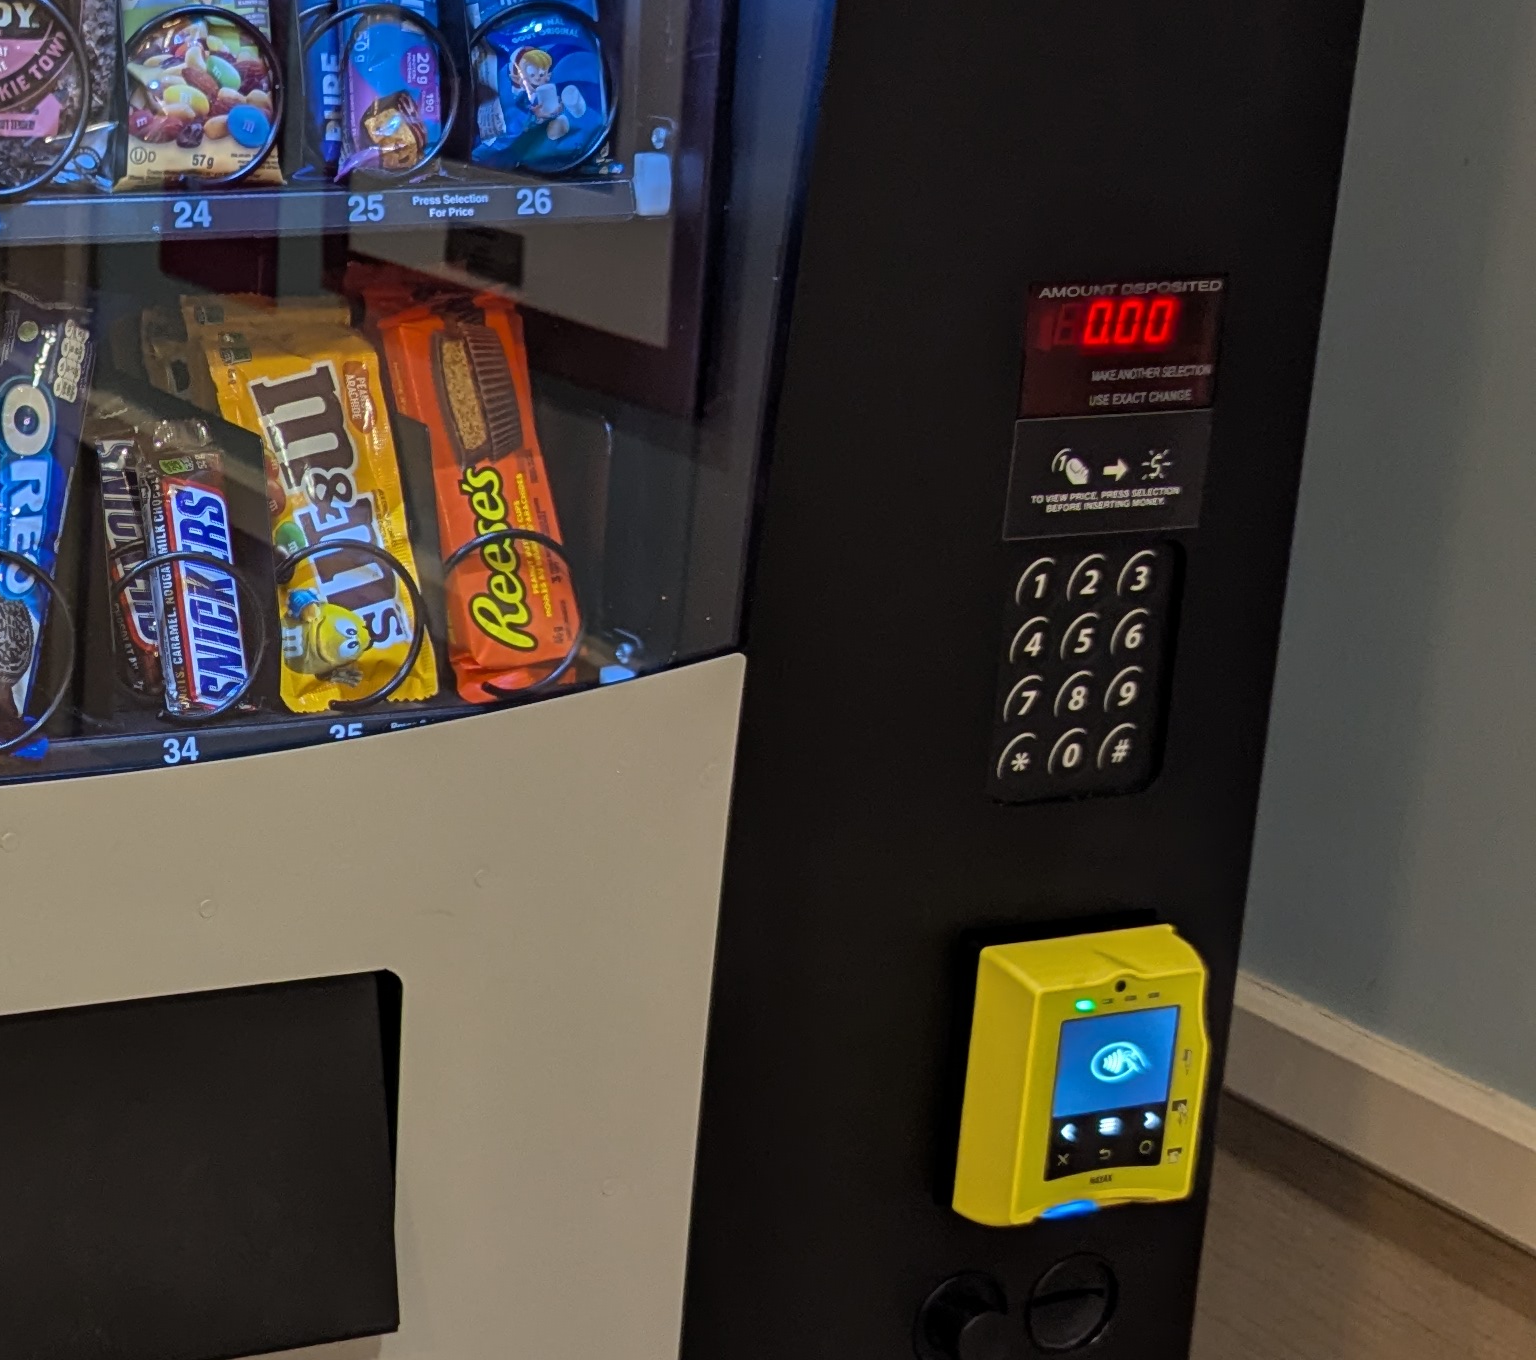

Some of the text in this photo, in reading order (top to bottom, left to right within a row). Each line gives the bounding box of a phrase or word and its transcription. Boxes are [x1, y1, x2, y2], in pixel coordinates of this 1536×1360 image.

[348, 194, 385, 222] 25
[412, 192, 489, 206] Press Selection
[516, 187, 553, 215] 26
[173, 200, 212, 229] 24
[428, 206, 475, 218] For Price
[1038, 279, 1223, 299] AMOUNT DEPOSITED
[1091, 364, 1212, 382] MAKE ANOTHER SELECTION
[1089, 389, 1193, 406] USE EXACT CHANGE
[2, 384, 51, 596] OREO
[1031, 495, 1043, 504] TO
[1045, 494, 1068, 504] VIEW
[1101, 489, 1130, 500] PRESS
[1131, 486, 1181, 499] SELECTION
[1045, 502, 1082, 514] BEFORE
[1083, 499, 1130, 512] INSERTING
[461, 467, 535, 649] Reese's
[1033, 573, 1048, 599] 1
[1079, 569, 1102, 595] 2
[1129, 566, 1151, 591] 3
[175, 488, 247, 702] SNICKERS
[1024, 632, 1044, 657] 4
[1073, 628, 1095, 654] 5
[1124, 624, 1146, 649] 6
[1017, 690, 1038, 716] 7
[1067, 686, 1089, 711] 8
[1117, 681, 1137, 707] 9
[163, 737, 200, 764] 34
[1062, 743, 1083, 768] 0
